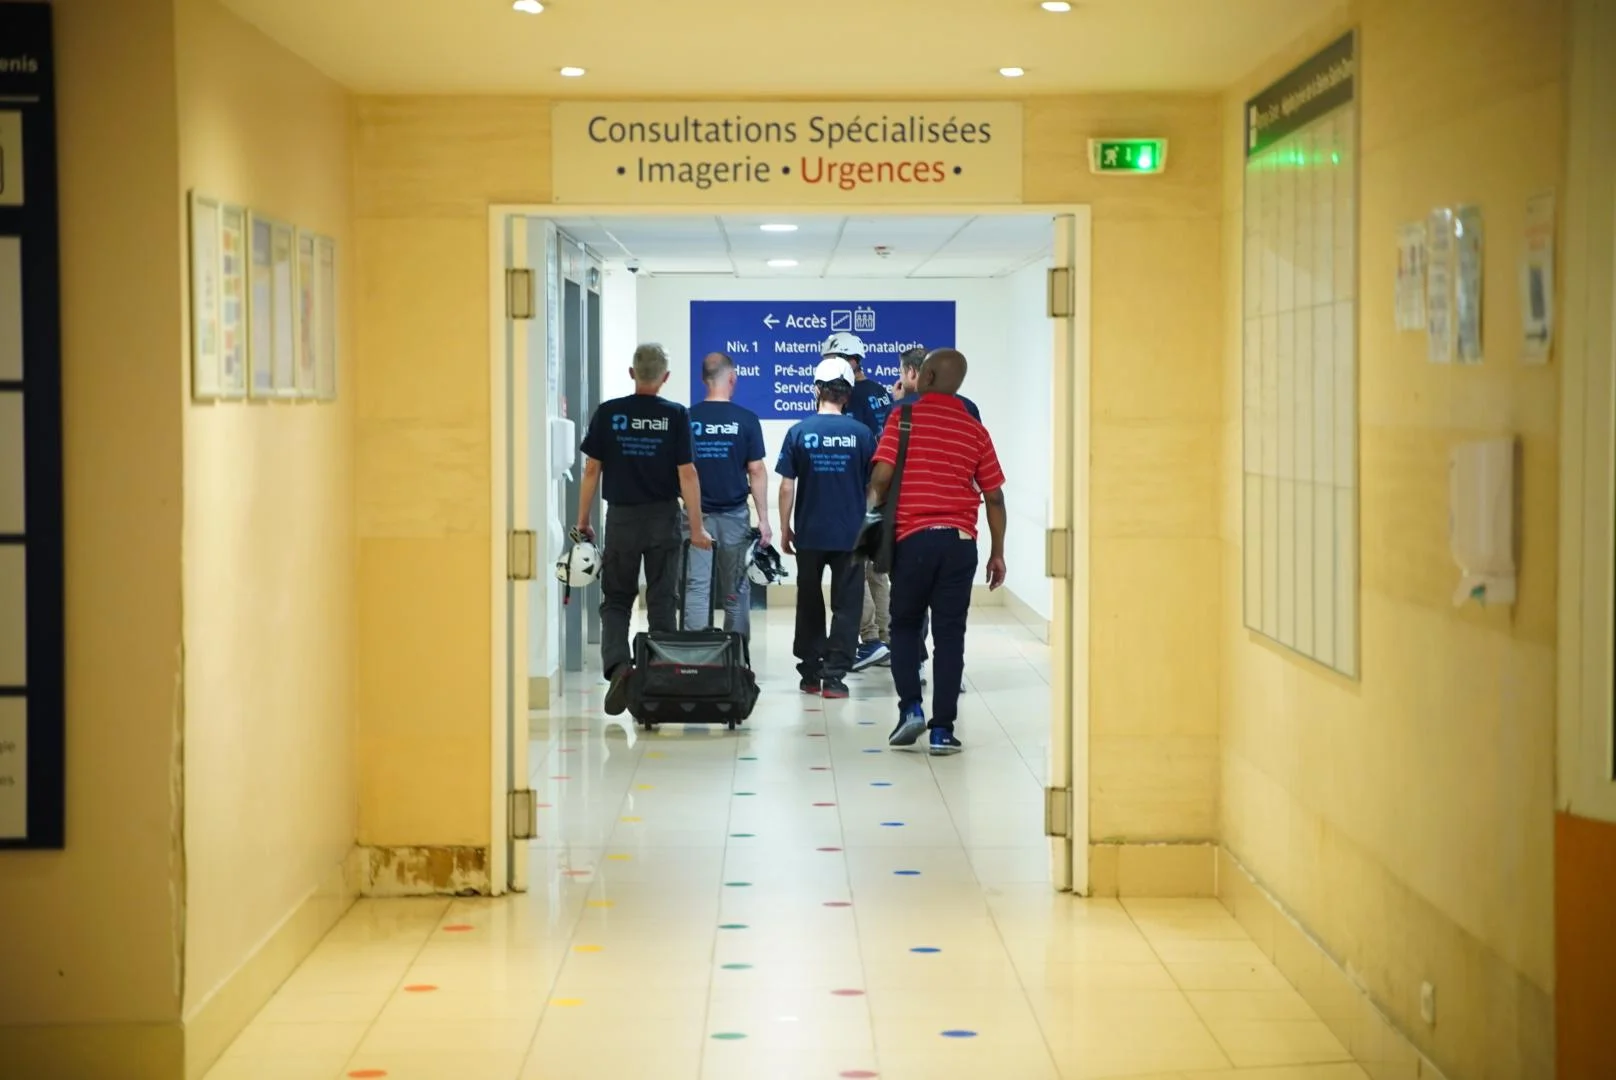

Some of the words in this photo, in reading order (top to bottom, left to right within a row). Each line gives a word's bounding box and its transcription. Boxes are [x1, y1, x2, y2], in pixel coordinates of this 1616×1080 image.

[588, 116, 797, 143] Consultations
[809, 116, 991, 148] Spécialisées
[637, 156, 770, 190] Imagerie
[800, 157, 945, 190] Urgences
[785, 313, 827, 329] Accès
[727, 341, 749, 353] Niv.
[752, 341, 759, 353] 1
[774, 341, 823, 353] Materni
